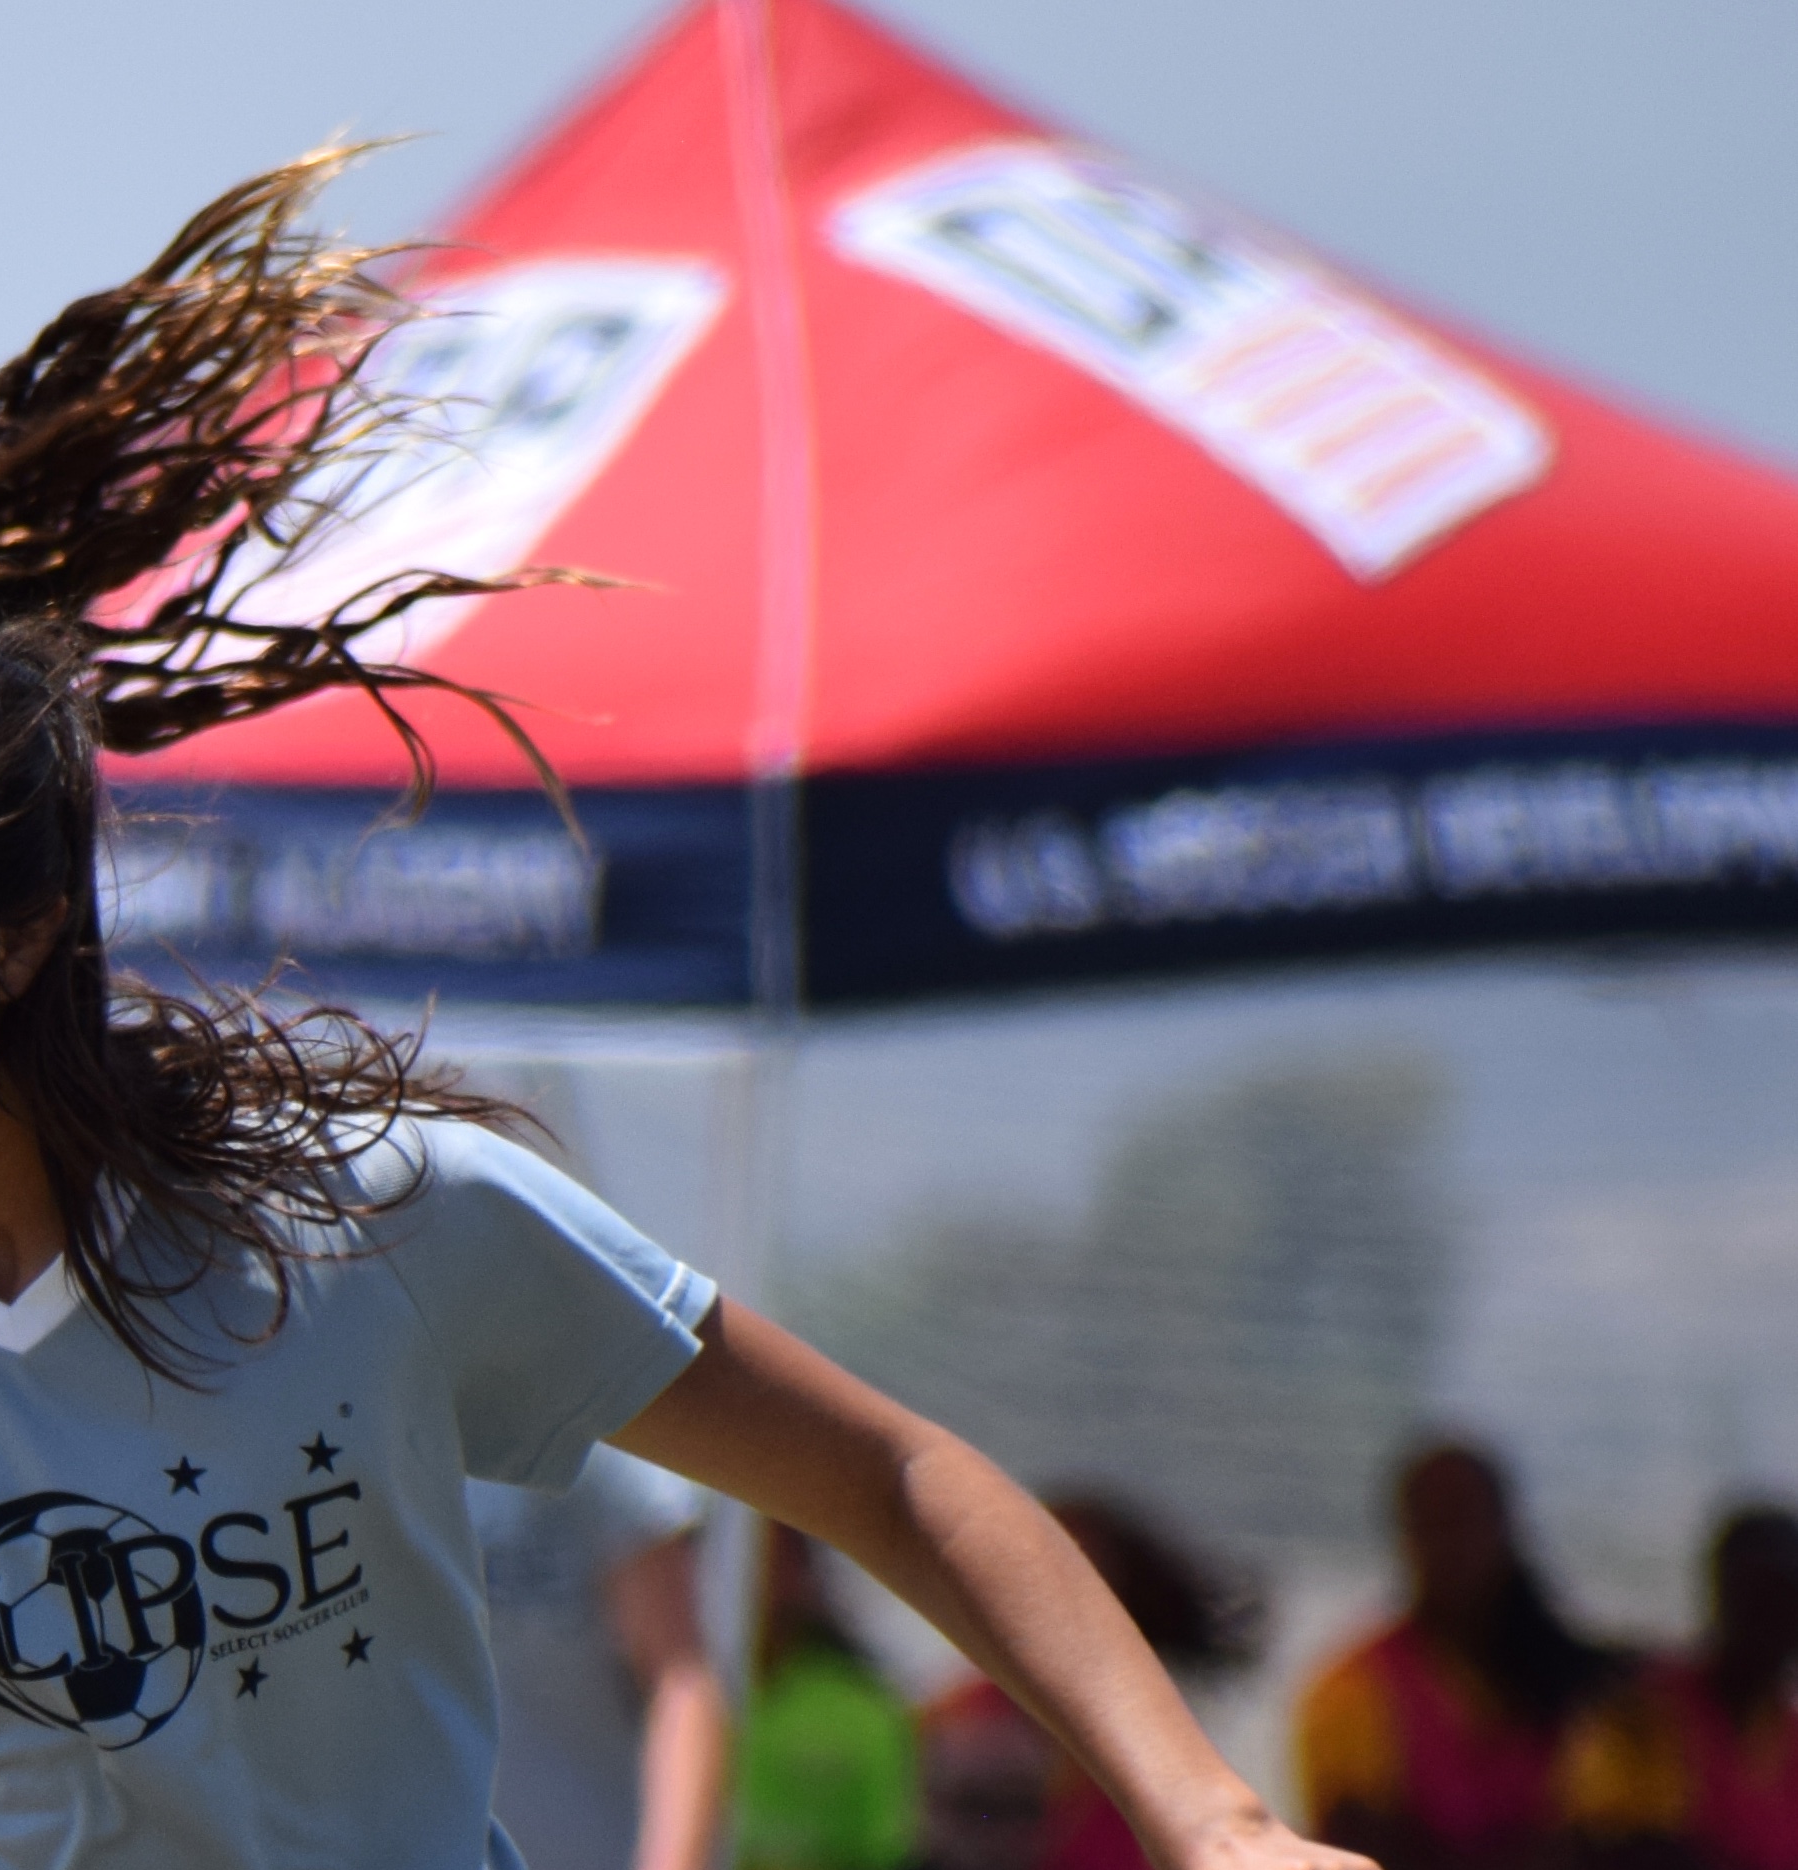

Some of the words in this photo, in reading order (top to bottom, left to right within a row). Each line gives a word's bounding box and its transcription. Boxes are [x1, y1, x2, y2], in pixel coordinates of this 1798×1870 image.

[209, 1632, 269, 1662] SELECT
[271, 1606, 332, 1644] SOCCER
[332, 1587, 371, 1616] CLUB
